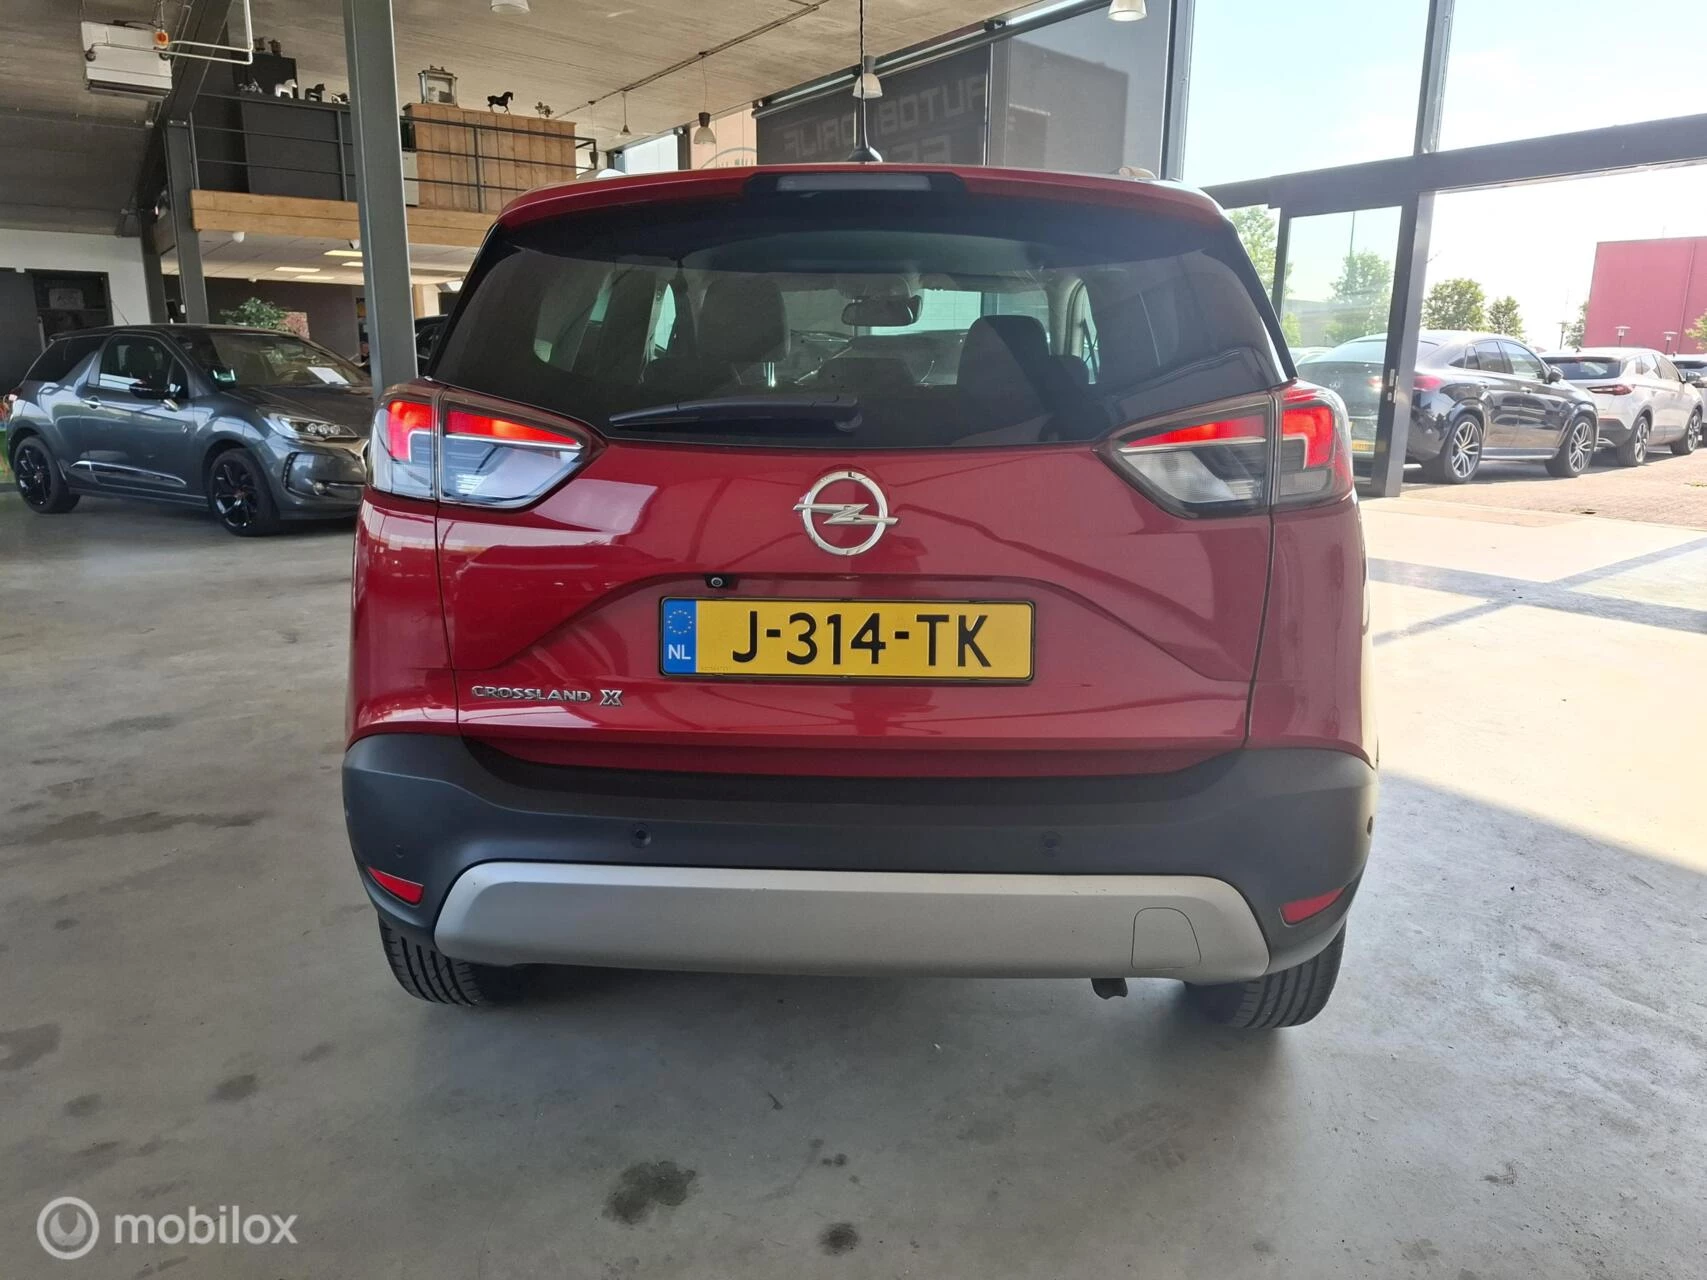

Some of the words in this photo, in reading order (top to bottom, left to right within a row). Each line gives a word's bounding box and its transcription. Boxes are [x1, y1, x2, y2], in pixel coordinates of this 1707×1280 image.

[732, 610, 992, 668] J-314-TK
[668, 643, 692, 661] NL
[472, 685, 592, 702] CROSSLAND
[599, 689, 623, 706] X
